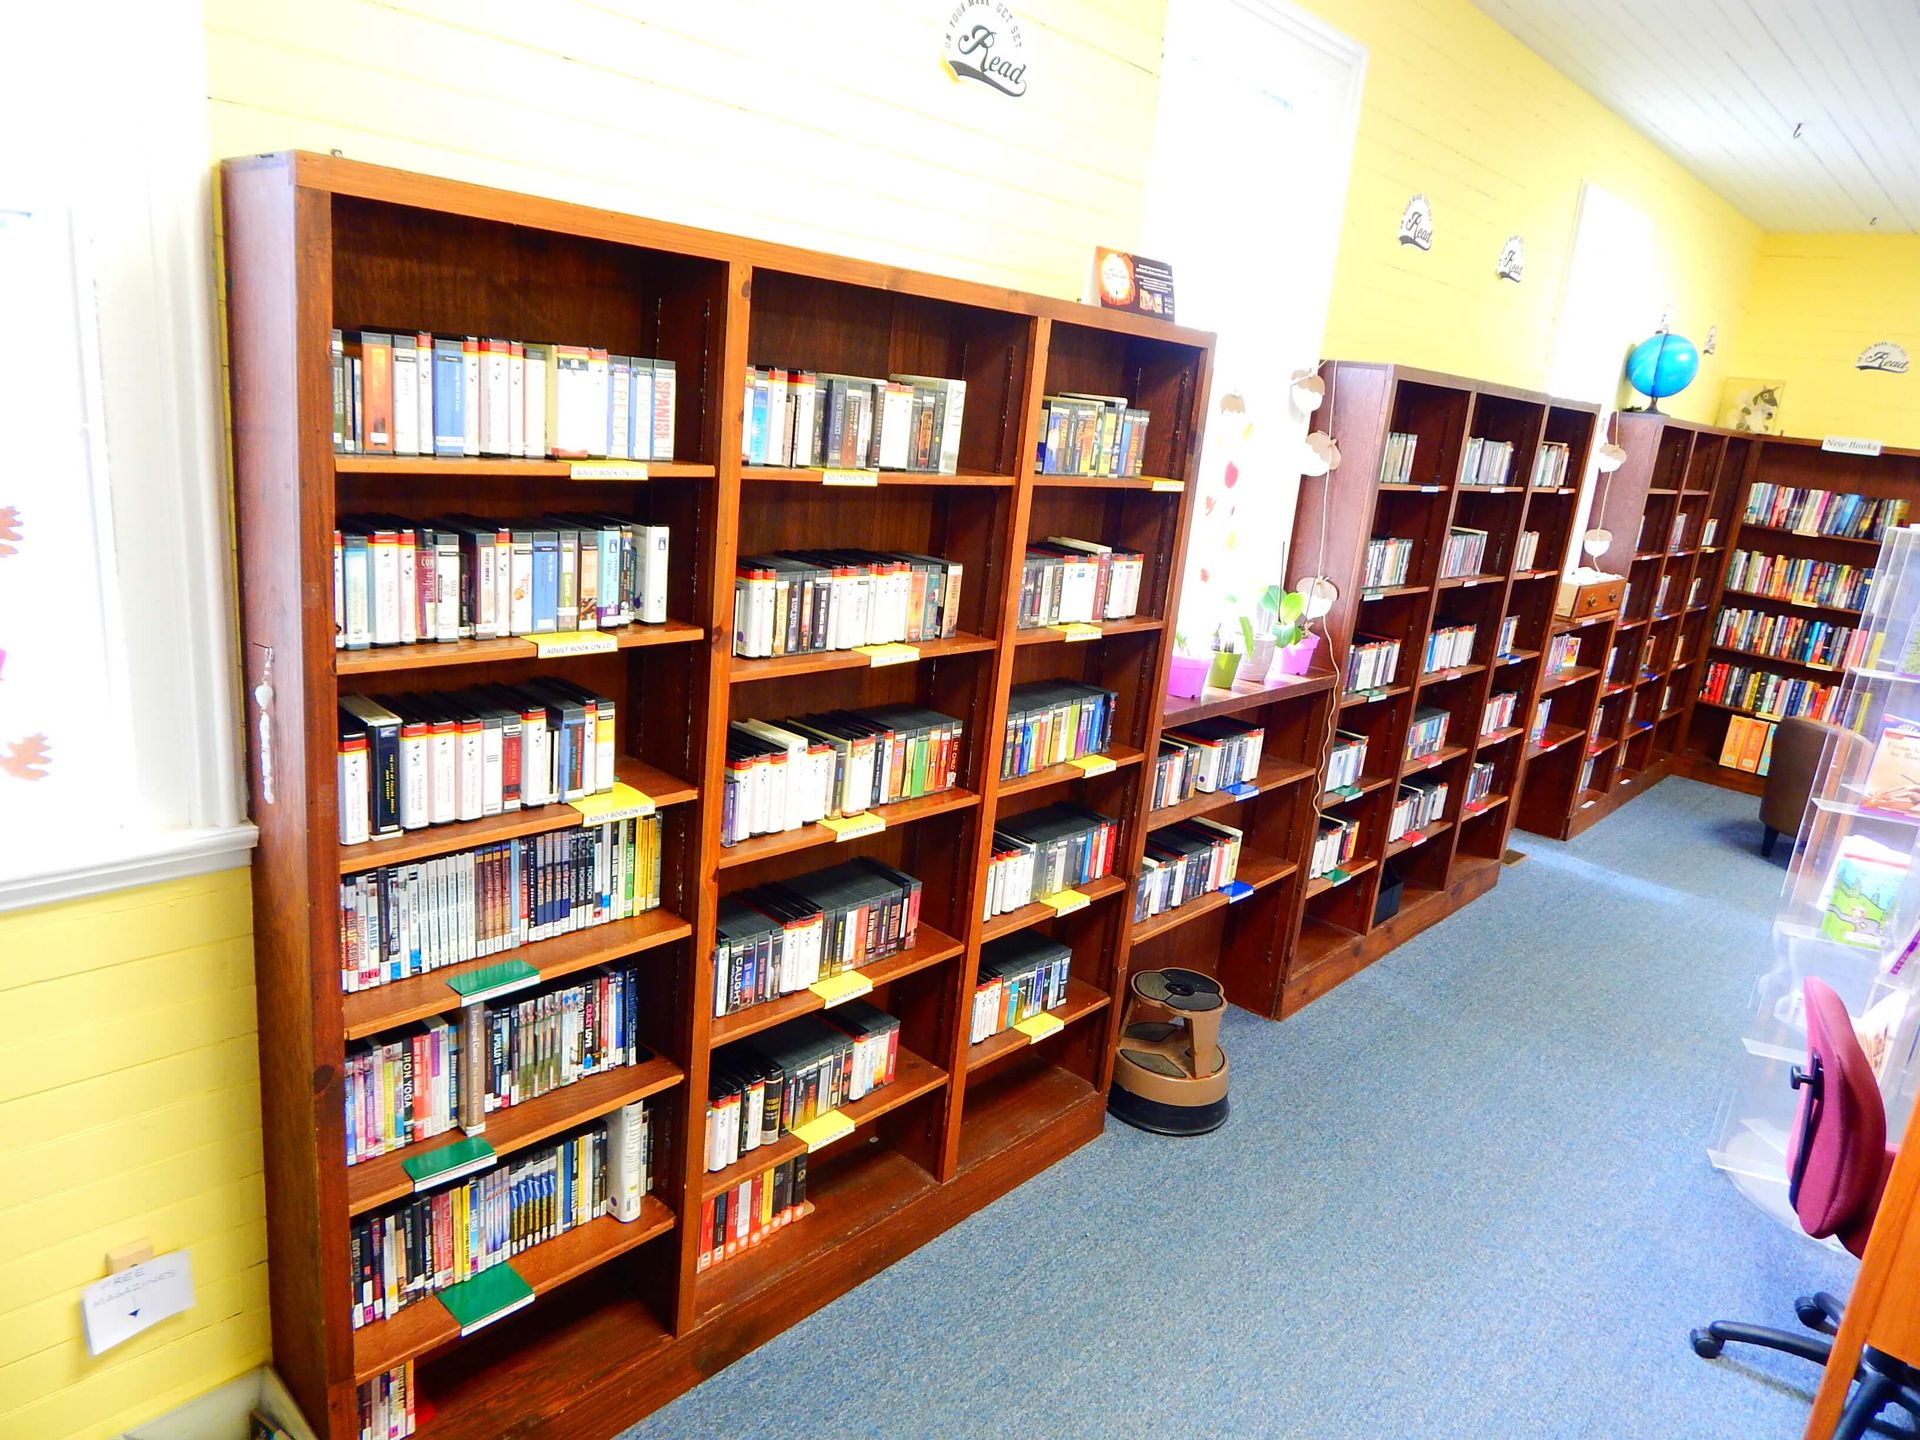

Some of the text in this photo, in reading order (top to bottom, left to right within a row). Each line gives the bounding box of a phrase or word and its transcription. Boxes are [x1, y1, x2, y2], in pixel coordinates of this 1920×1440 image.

[958, 24, 1026, 84] Read
[1406, 211, 1432, 243] Read
[1865, 351, 1909, 369] Read
[655, 381, 671, 440] SPANISH
[1825, 438, 1878, 451] New Books
[547, 646, 568, 654] ADULT
[570, 645, 589, 653] BOOK
[588, 813, 609, 822] ADULT
[611, 810, 628, 819] BOOK
[369, 915, 378, 950] BABIES
[734, 957, 743, 1006] CAUGHT
[585, 1003, 593, 1028] CRAZY
[494, 1033, 502, 1059] APOLLO
[404, 1053, 413, 1108] IRON YOGA
[470, 1209, 478, 1232] MERU
